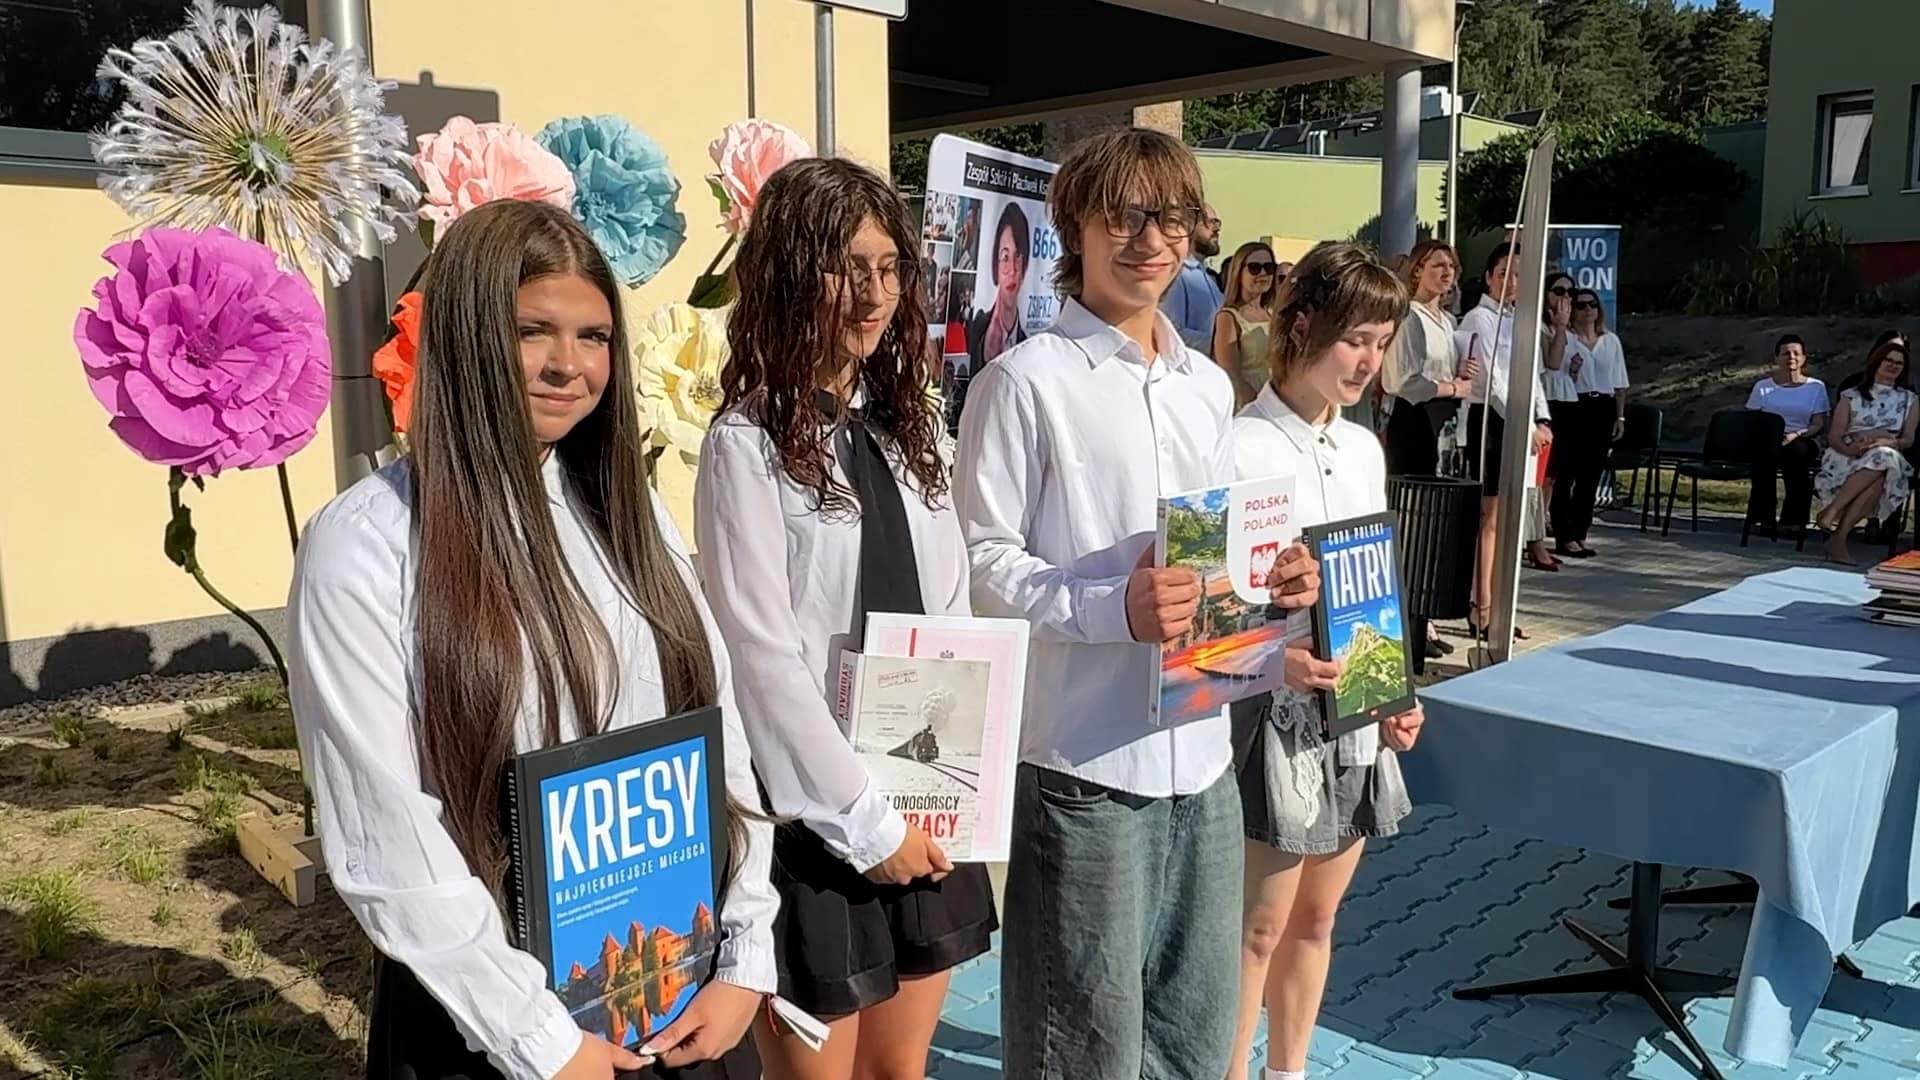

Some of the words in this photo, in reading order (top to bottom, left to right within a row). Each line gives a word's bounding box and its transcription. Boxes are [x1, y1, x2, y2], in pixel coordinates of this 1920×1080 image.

[1566, 237, 1608, 261] WO
[1243, 513, 1288, 533] POLAND
[1244, 493, 1289, 513] POLSKA
[1323, 538, 1393, 610] TATRY
[548, 750, 701, 883] KRESY
[555, 859, 654, 905] NAJPIĘKNIEJSZE
[659, 841, 705, 870] MIEJSCA
